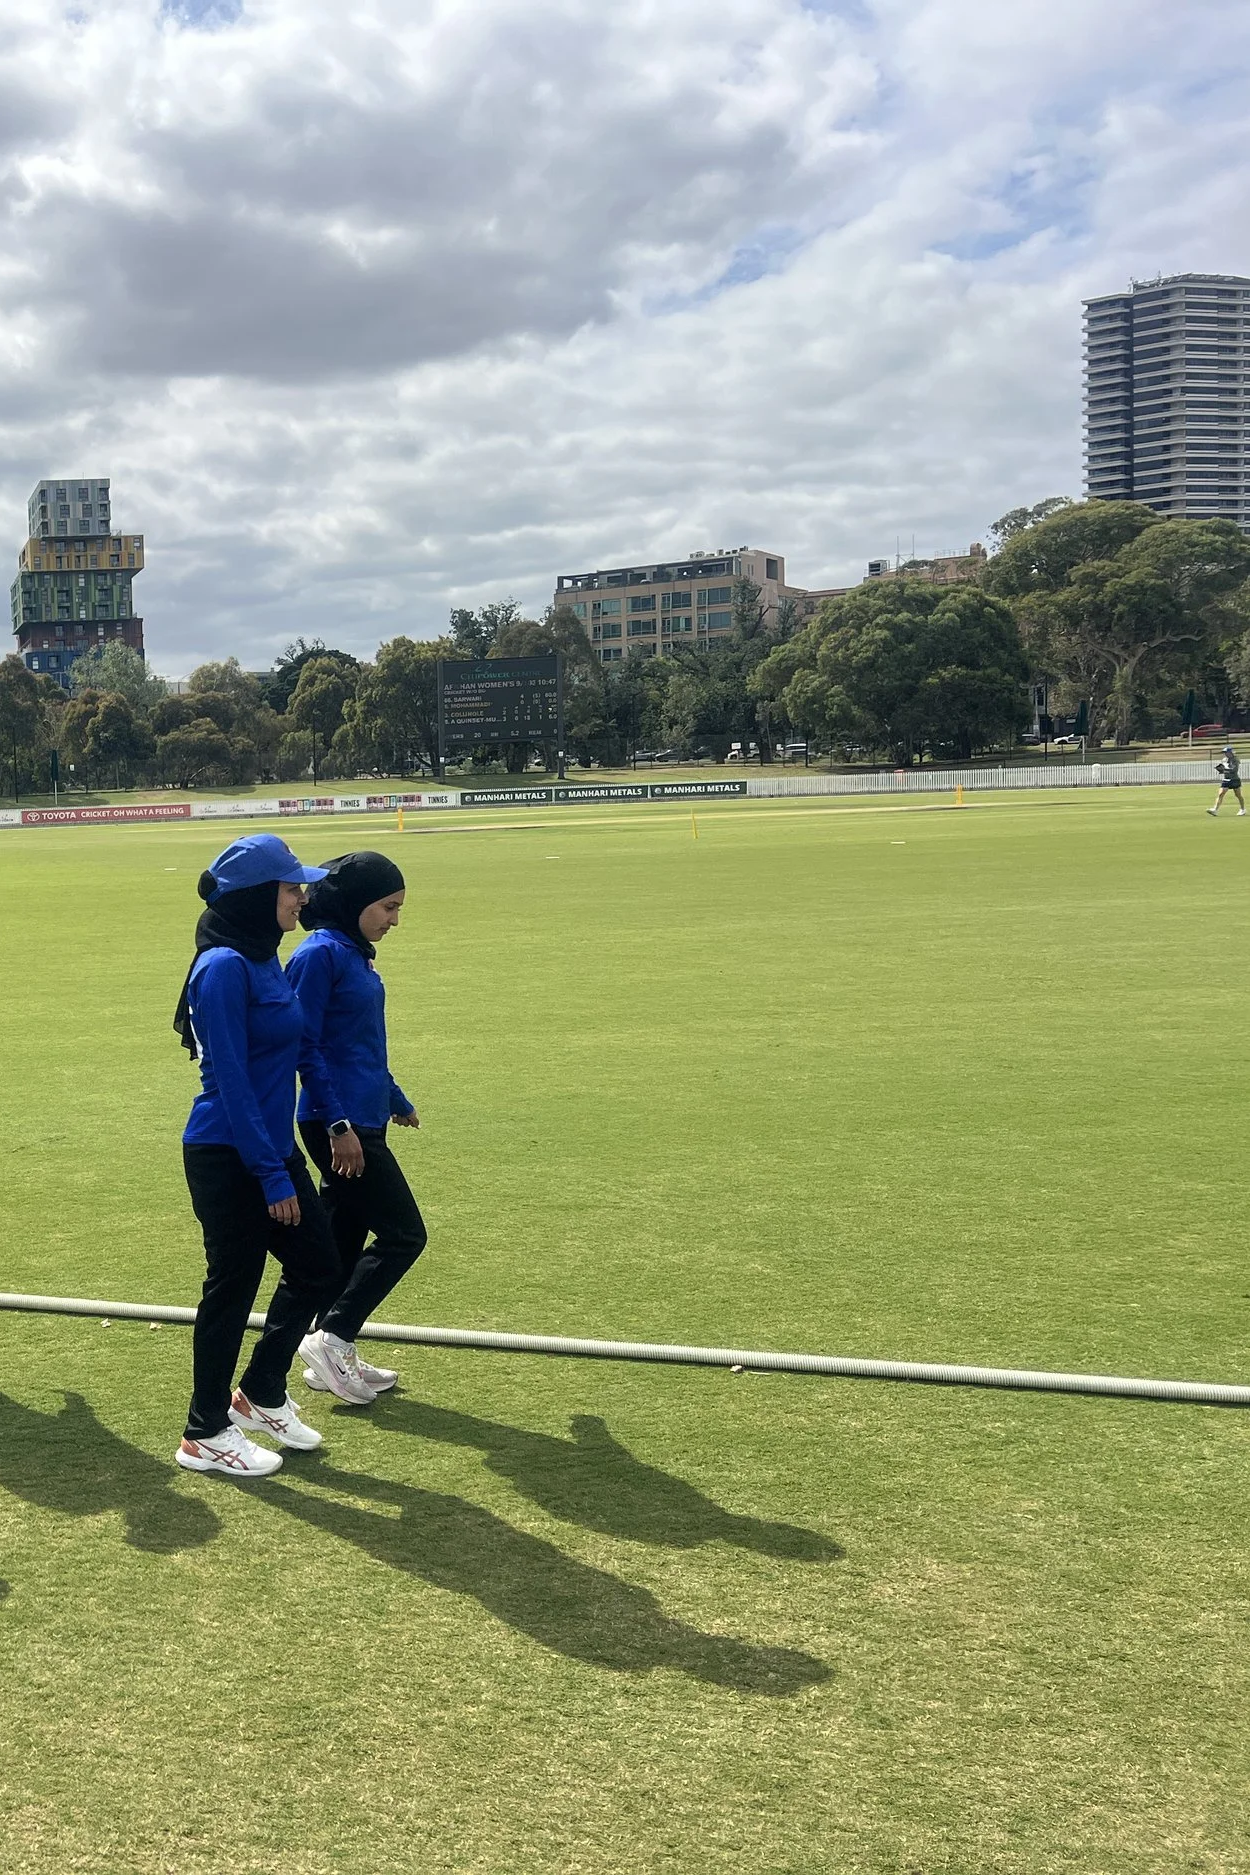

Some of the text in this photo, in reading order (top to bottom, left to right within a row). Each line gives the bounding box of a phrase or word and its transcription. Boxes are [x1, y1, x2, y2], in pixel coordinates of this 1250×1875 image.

[568, 788, 642, 798] MANHARI METALS
[664, 784, 740, 794] MANHARI METALS
[474, 792, 546, 801] MANHARI METALS
[42, 812, 76, 820] TOYOTA
